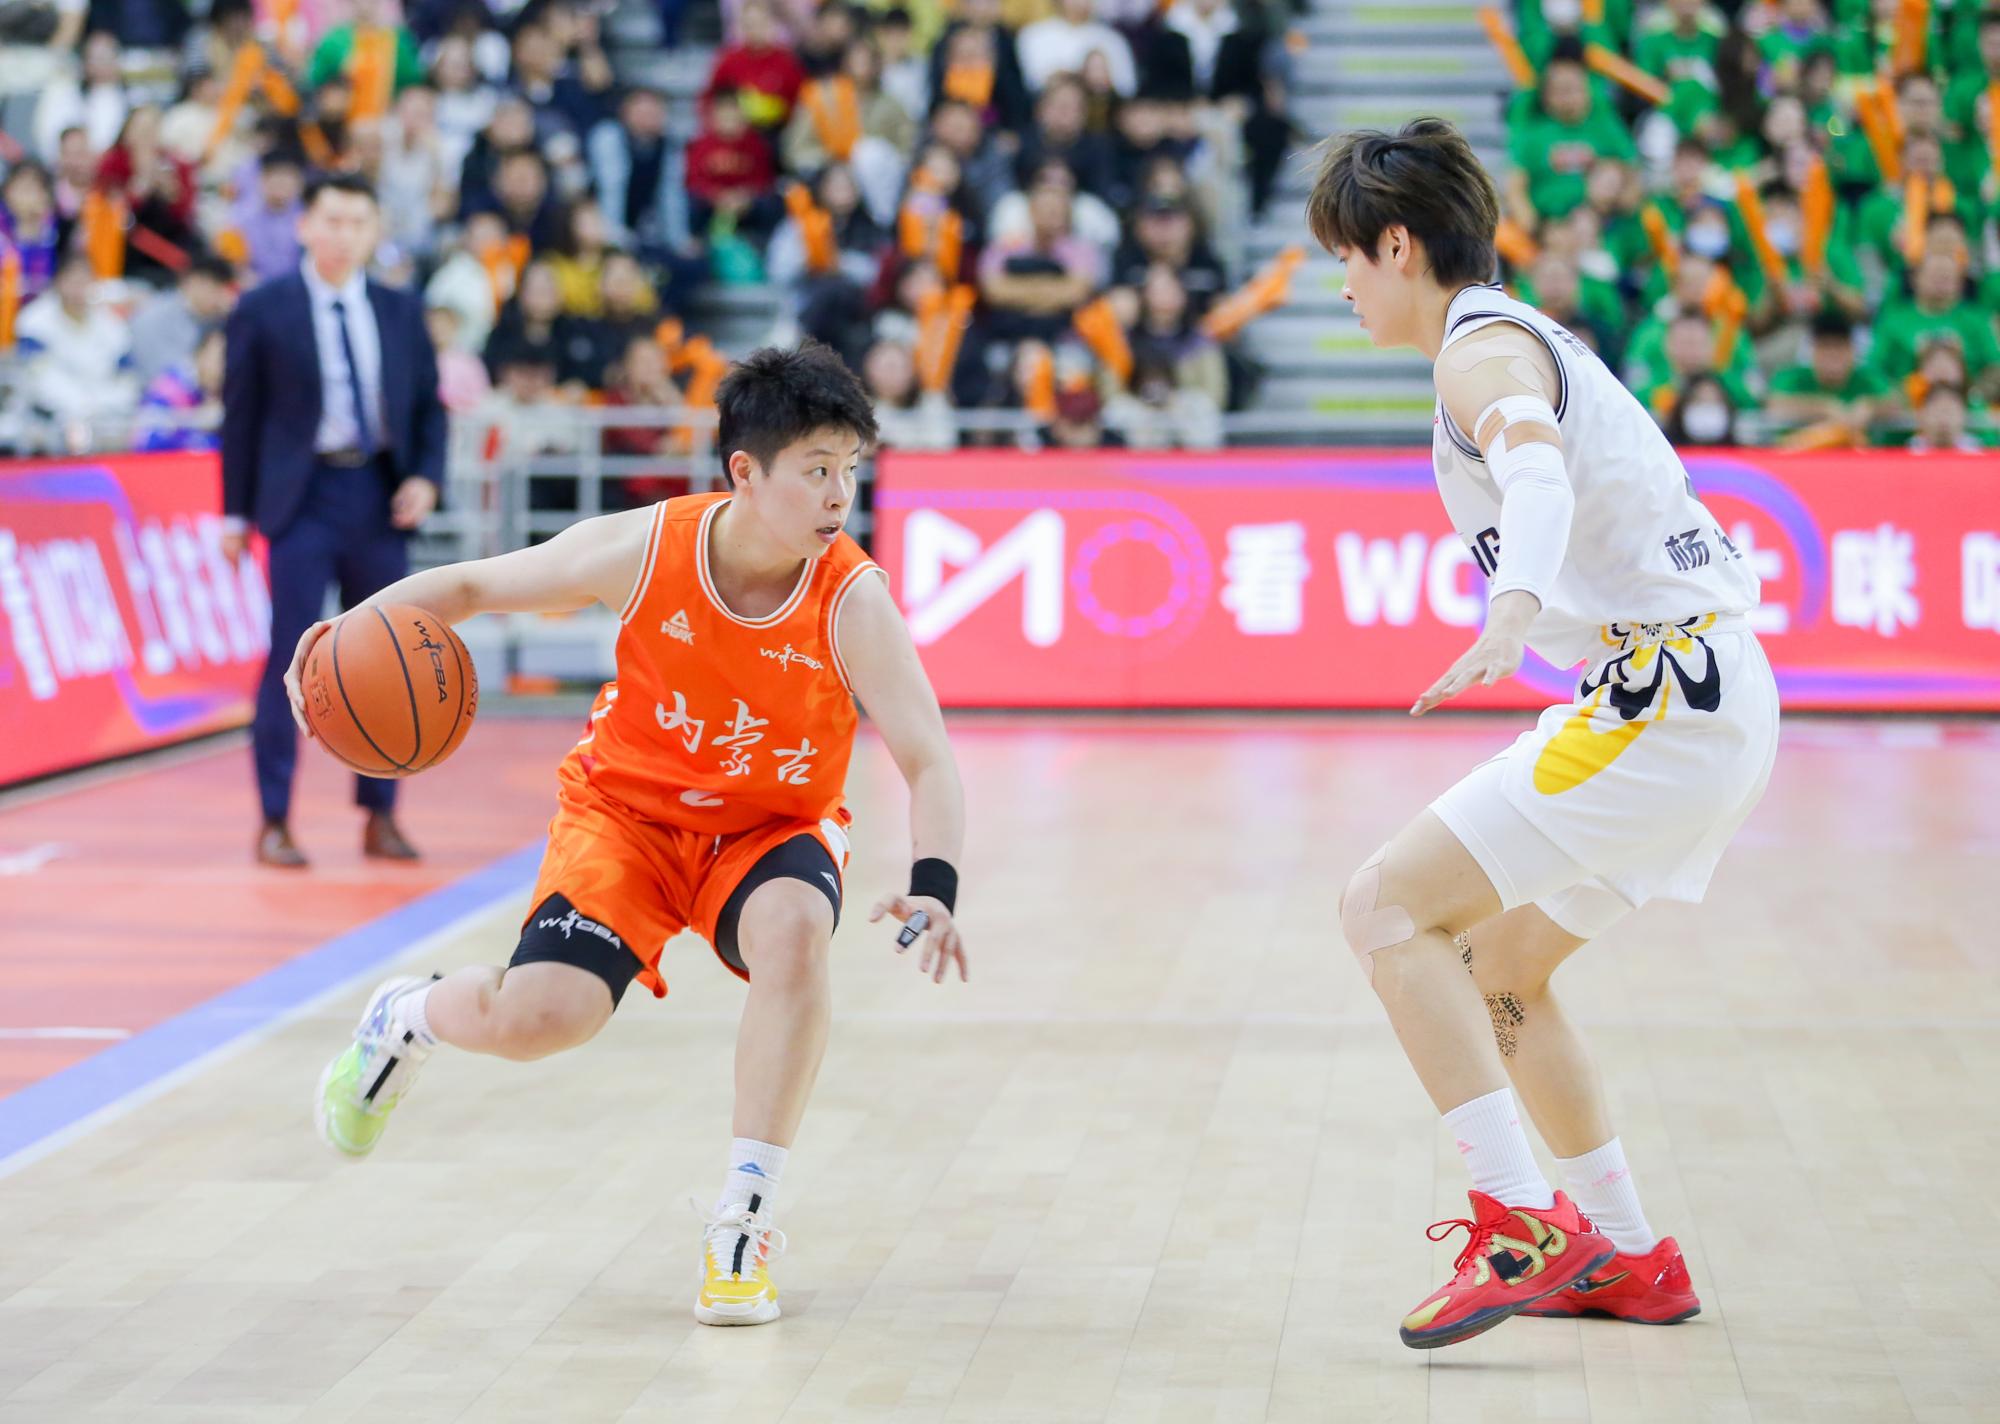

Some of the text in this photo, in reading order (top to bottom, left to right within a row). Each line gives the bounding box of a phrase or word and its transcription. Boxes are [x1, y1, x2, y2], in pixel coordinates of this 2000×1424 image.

[413, 620, 448, 704] WCBA
[759, 643, 824, 672] WCBA
[655, 690, 818, 785] 内蒙古
[538, 909, 621, 950] WCBA
